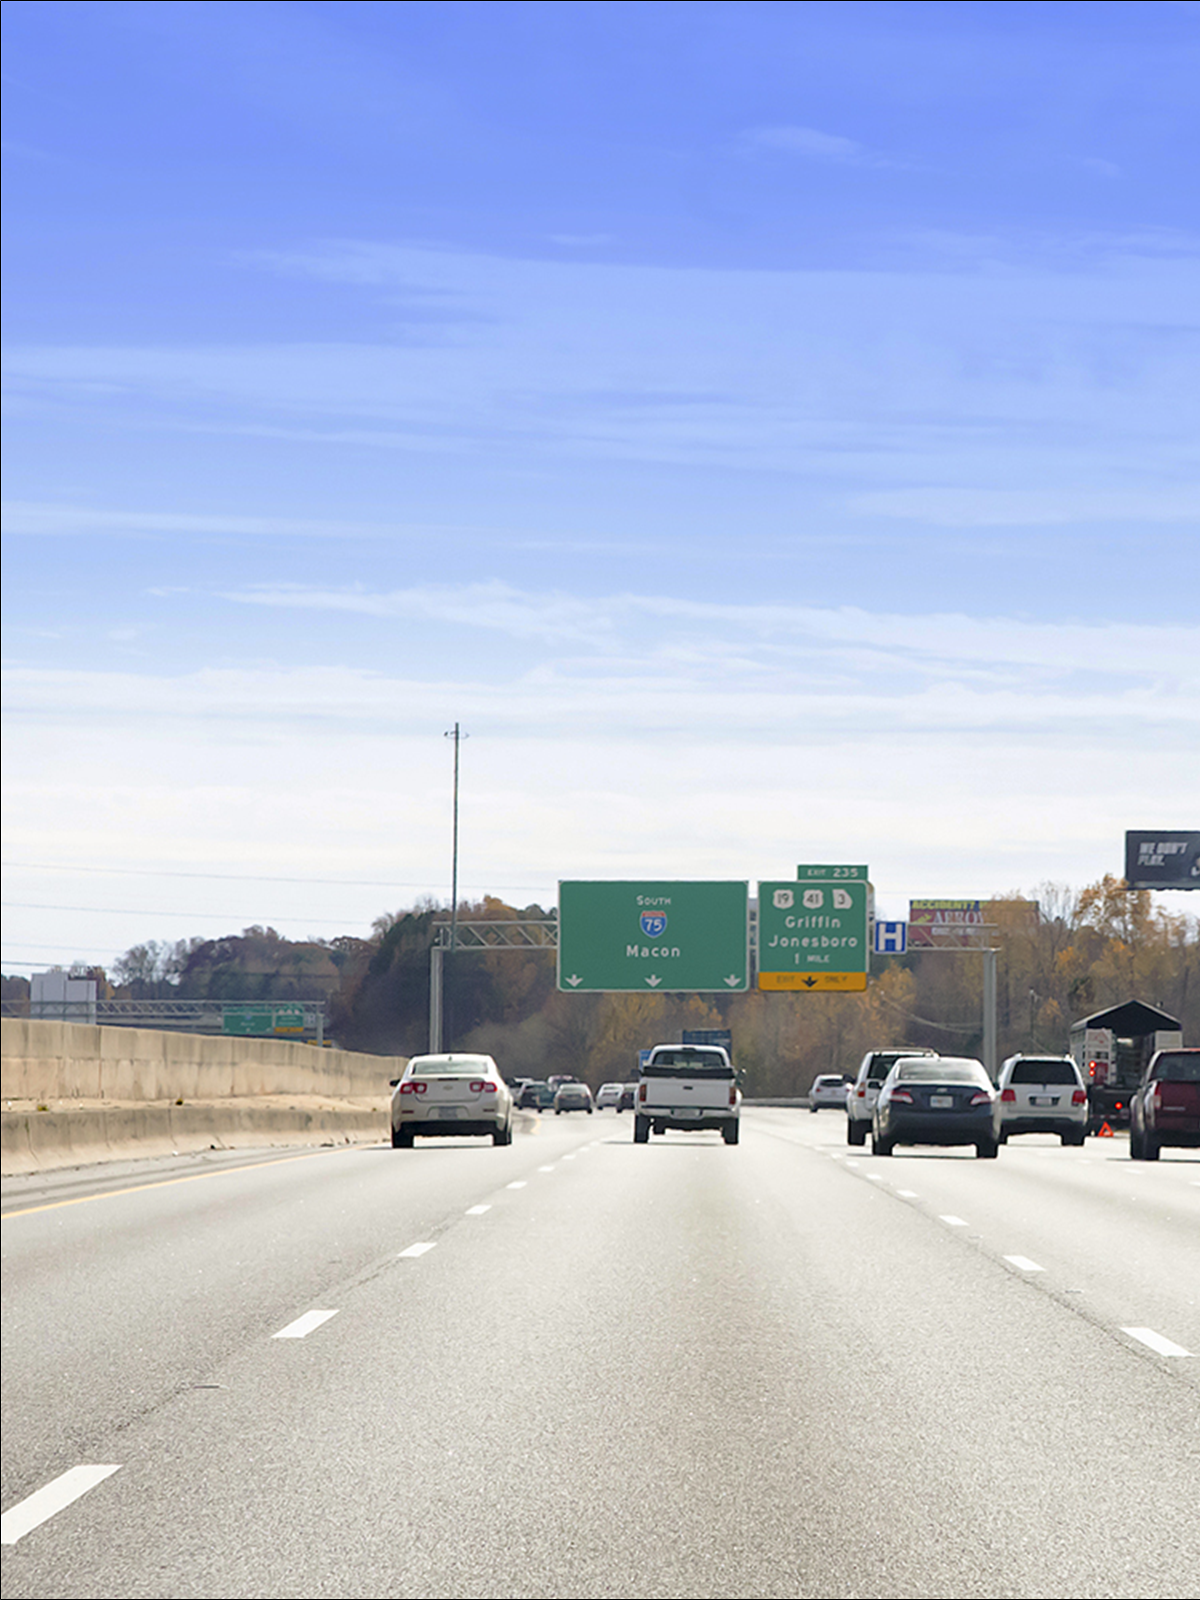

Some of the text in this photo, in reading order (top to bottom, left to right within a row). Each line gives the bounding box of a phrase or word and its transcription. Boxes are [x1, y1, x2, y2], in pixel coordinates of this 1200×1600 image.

[807, 867, 859, 878] EXIT 235
[777, 893, 846, 905] 19 41 3
[645, 918, 663, 932] 75
[785, 916, 842, 928] Griffin
[768, 935, 858, 948] Jonesboro
[878, 923, 903, 950] H
[626, 945, 681, 957] Macon
[795, 953, 830, 964] 1 MILE
